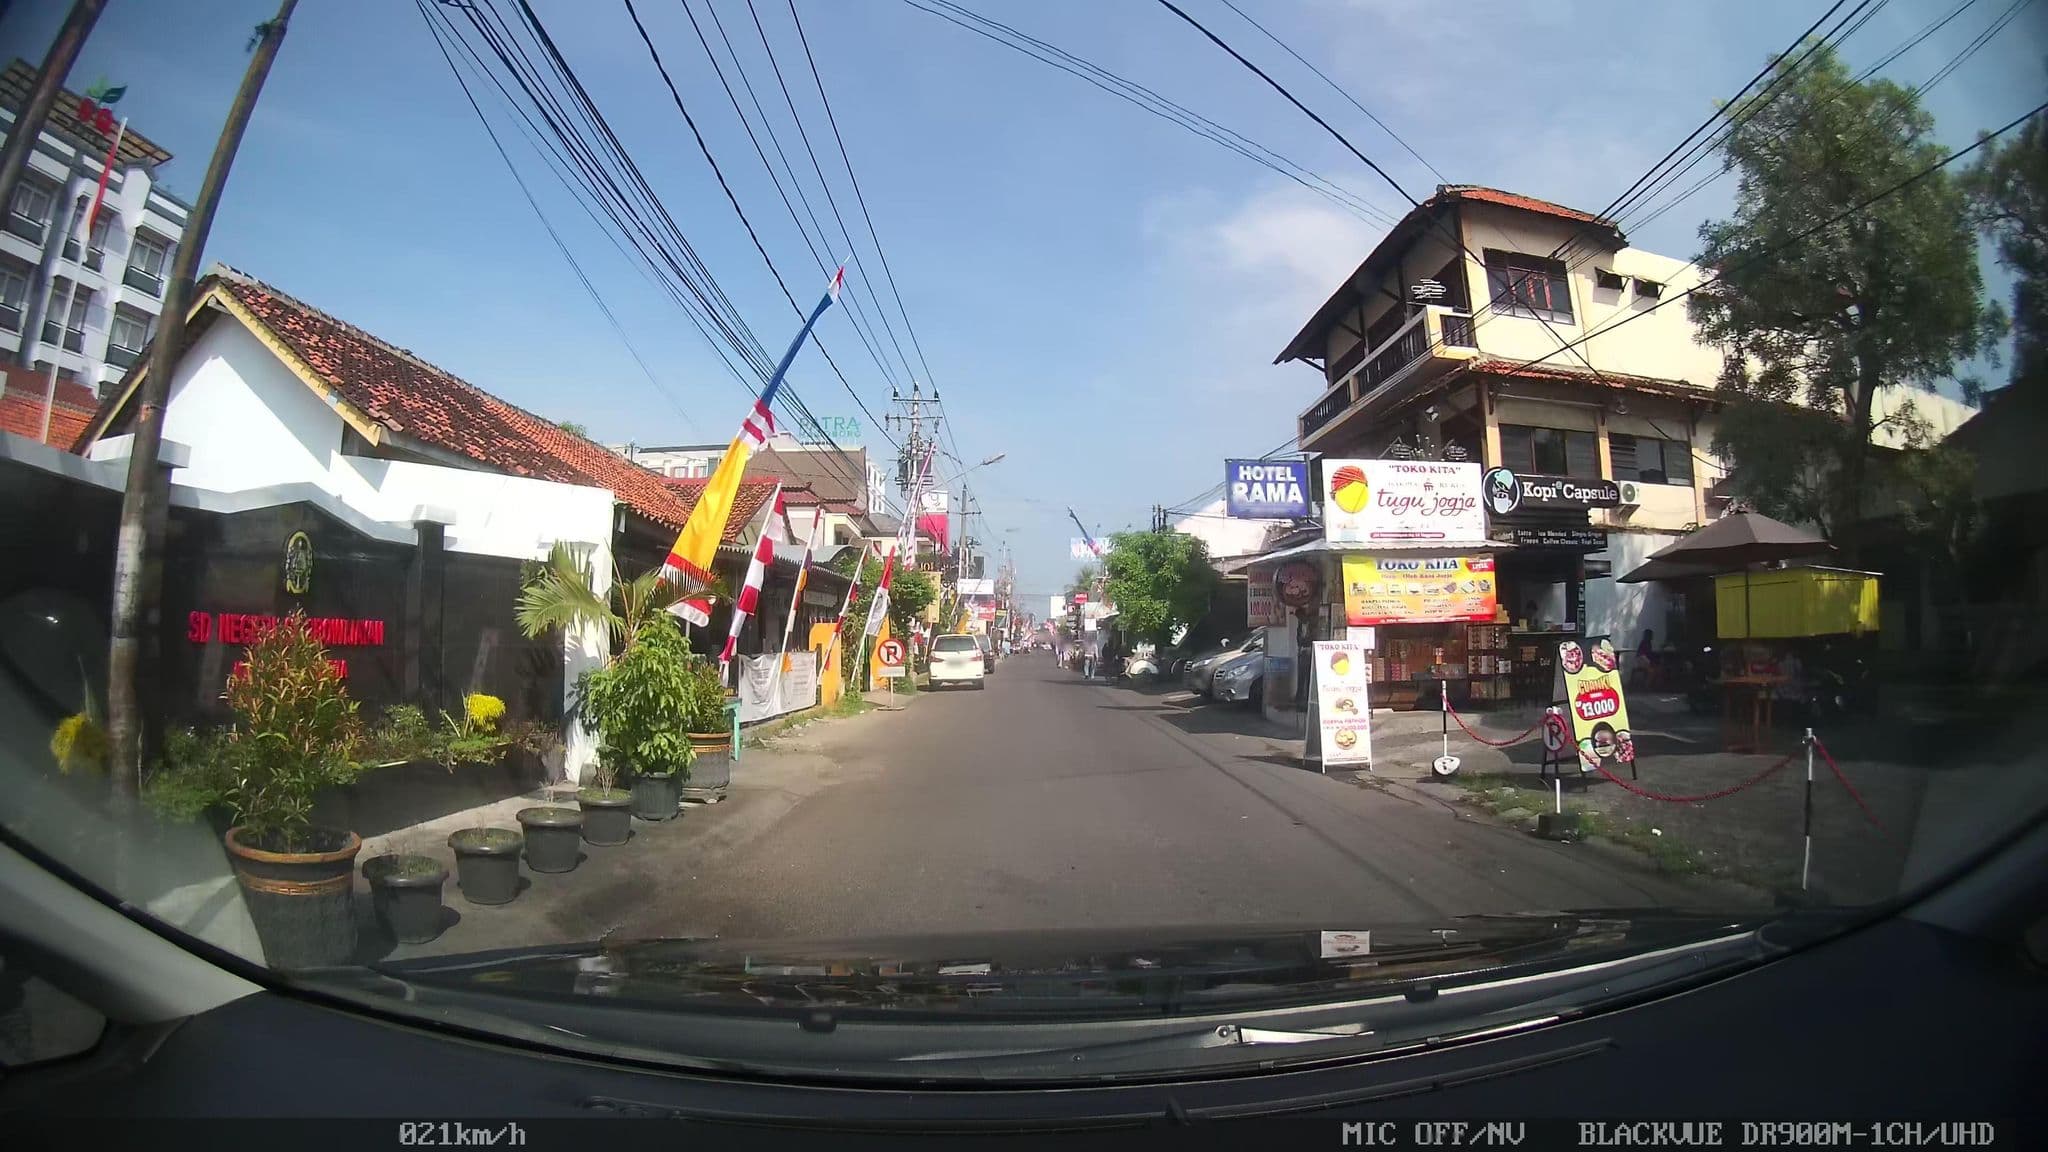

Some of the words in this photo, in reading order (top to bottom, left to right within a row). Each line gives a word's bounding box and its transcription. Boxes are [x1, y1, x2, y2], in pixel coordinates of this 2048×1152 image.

[1238, 465, 1297, 482] HOTEL
[1233, 482, 1305, 504] RAMA
[1376, 488, 1425, 516] tugu
[1420, 491, 1477, 517] jogja
[1522, 481, 1558, 502] Kopi
[1562, 484, 1618, 503] Capsule
[187, 611, 212, 643] SD
